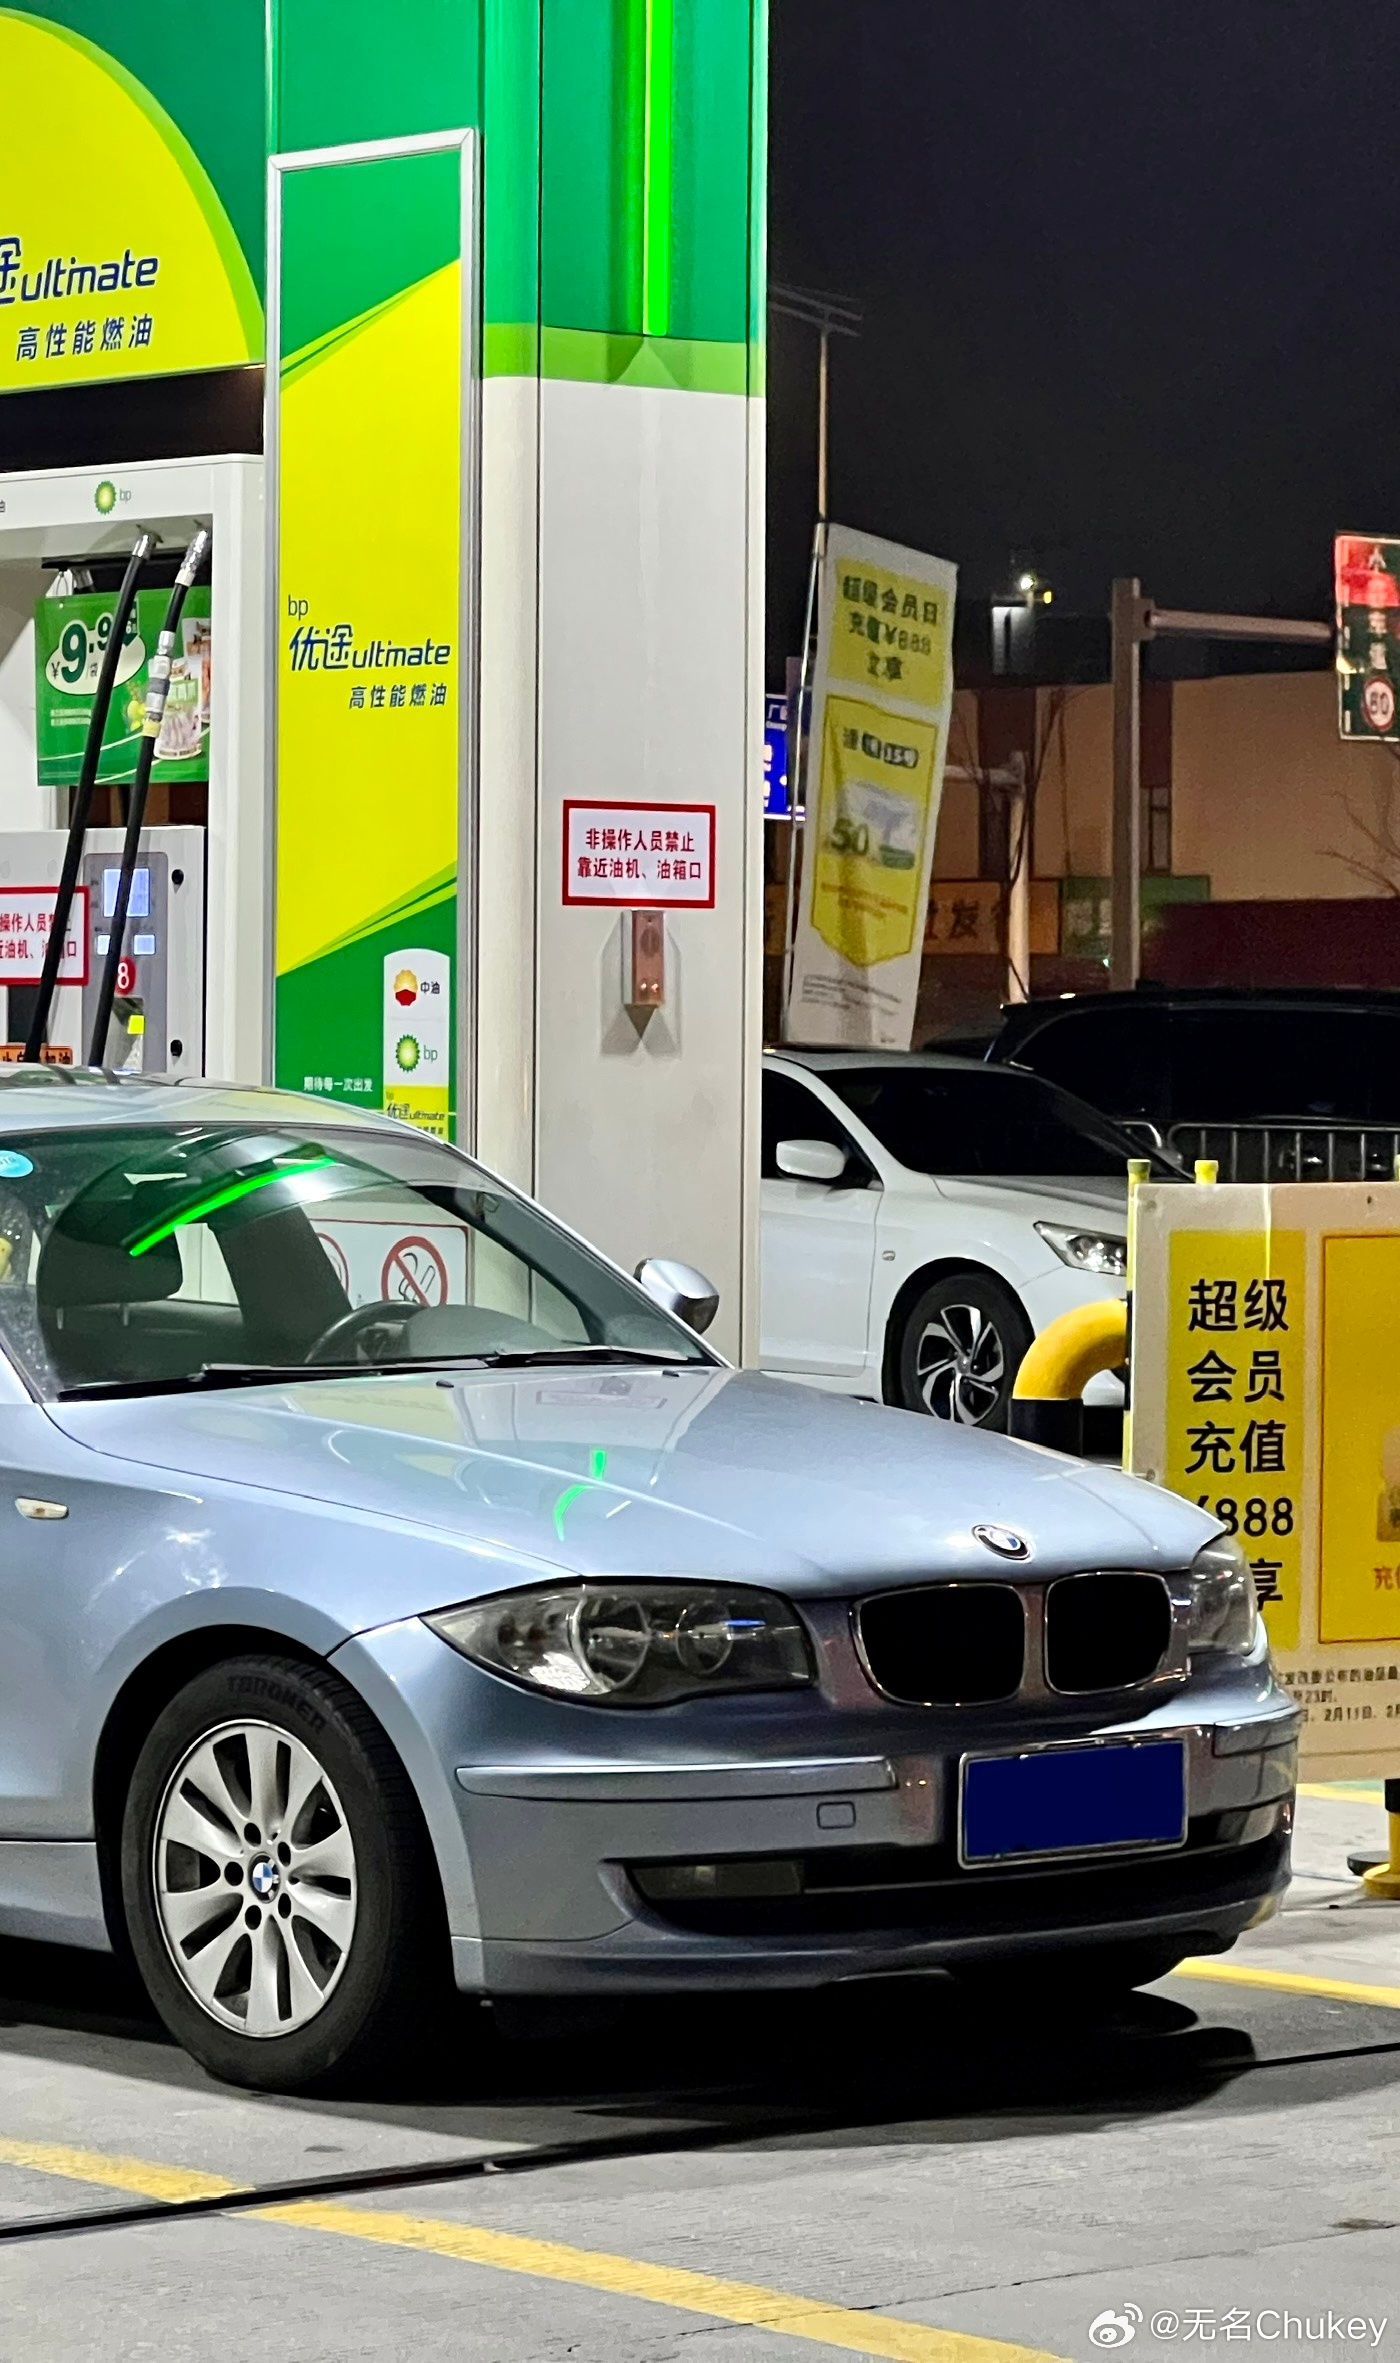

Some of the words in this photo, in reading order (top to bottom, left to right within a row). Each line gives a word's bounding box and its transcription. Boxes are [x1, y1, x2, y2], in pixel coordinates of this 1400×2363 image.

[16, 313, 153, 361] 高性能燃油
[120, 487, 132, 502] bp
[288, 594, 309, 621] bp
[349, 683, 448, 709] 高性能燃油
[585, 827, 695, 853] 非操作人员禁止
[577, 856, 702, 880] 靠近油机、油箱口
[117, 962, 130, 989] 8
[420, 981, 441, 995] 中油
[423, 1045, 438, 1063] bp
[1188, 1278, 1289, 1332] 超级
[1187, 1350, 1285, 1403] 会员
[1185, 1419, 1286, 1474] 充值
